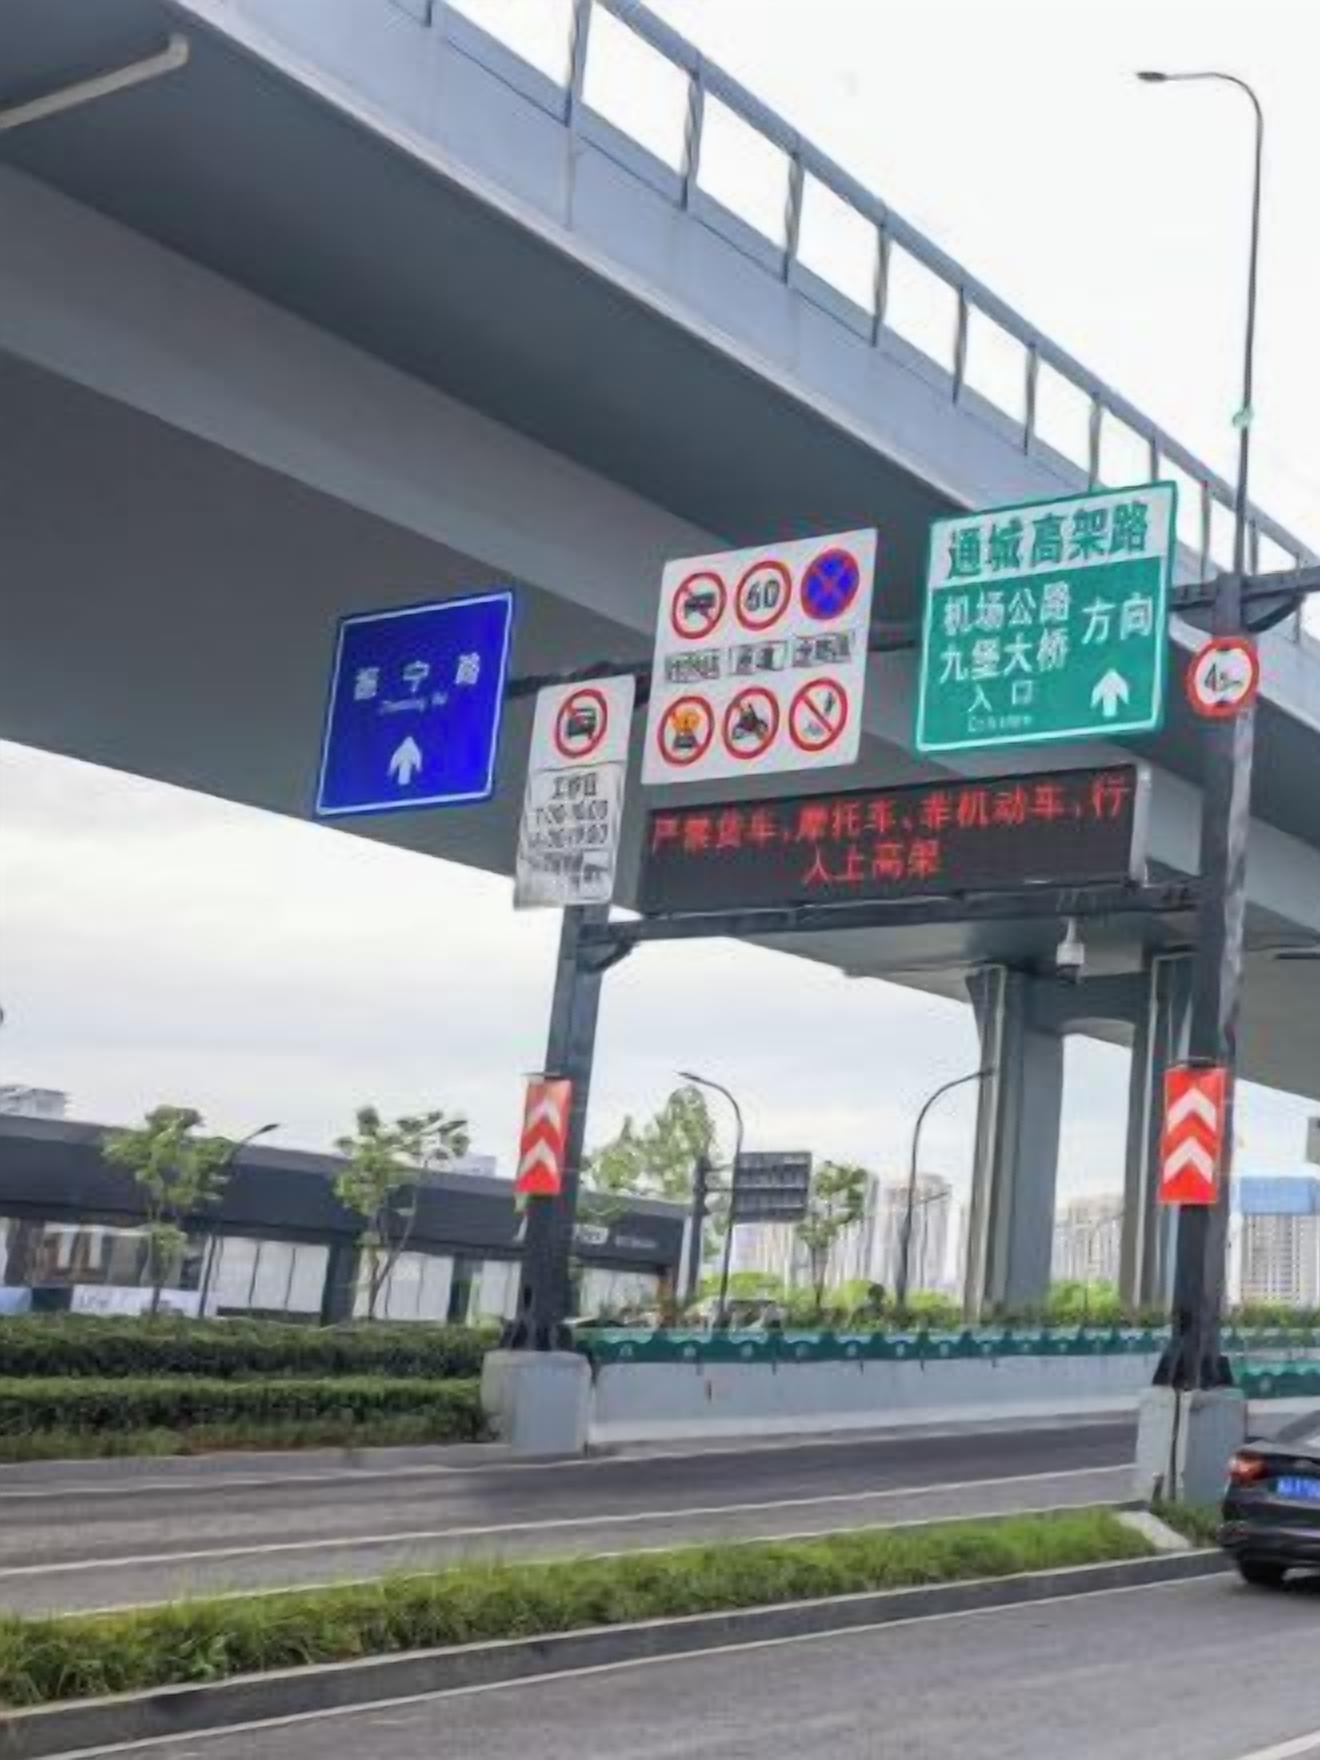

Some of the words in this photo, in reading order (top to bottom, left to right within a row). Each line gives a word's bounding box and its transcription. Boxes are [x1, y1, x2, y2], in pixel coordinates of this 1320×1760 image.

[744, 577, 782, 613] 60
[943, 581, 1070, 637] 机场公路
[1082, 592, 1154, 645] 方向
[938, 627, 1069, 684] 九堡大桥
[967, 680, 1034, 714] 入口
